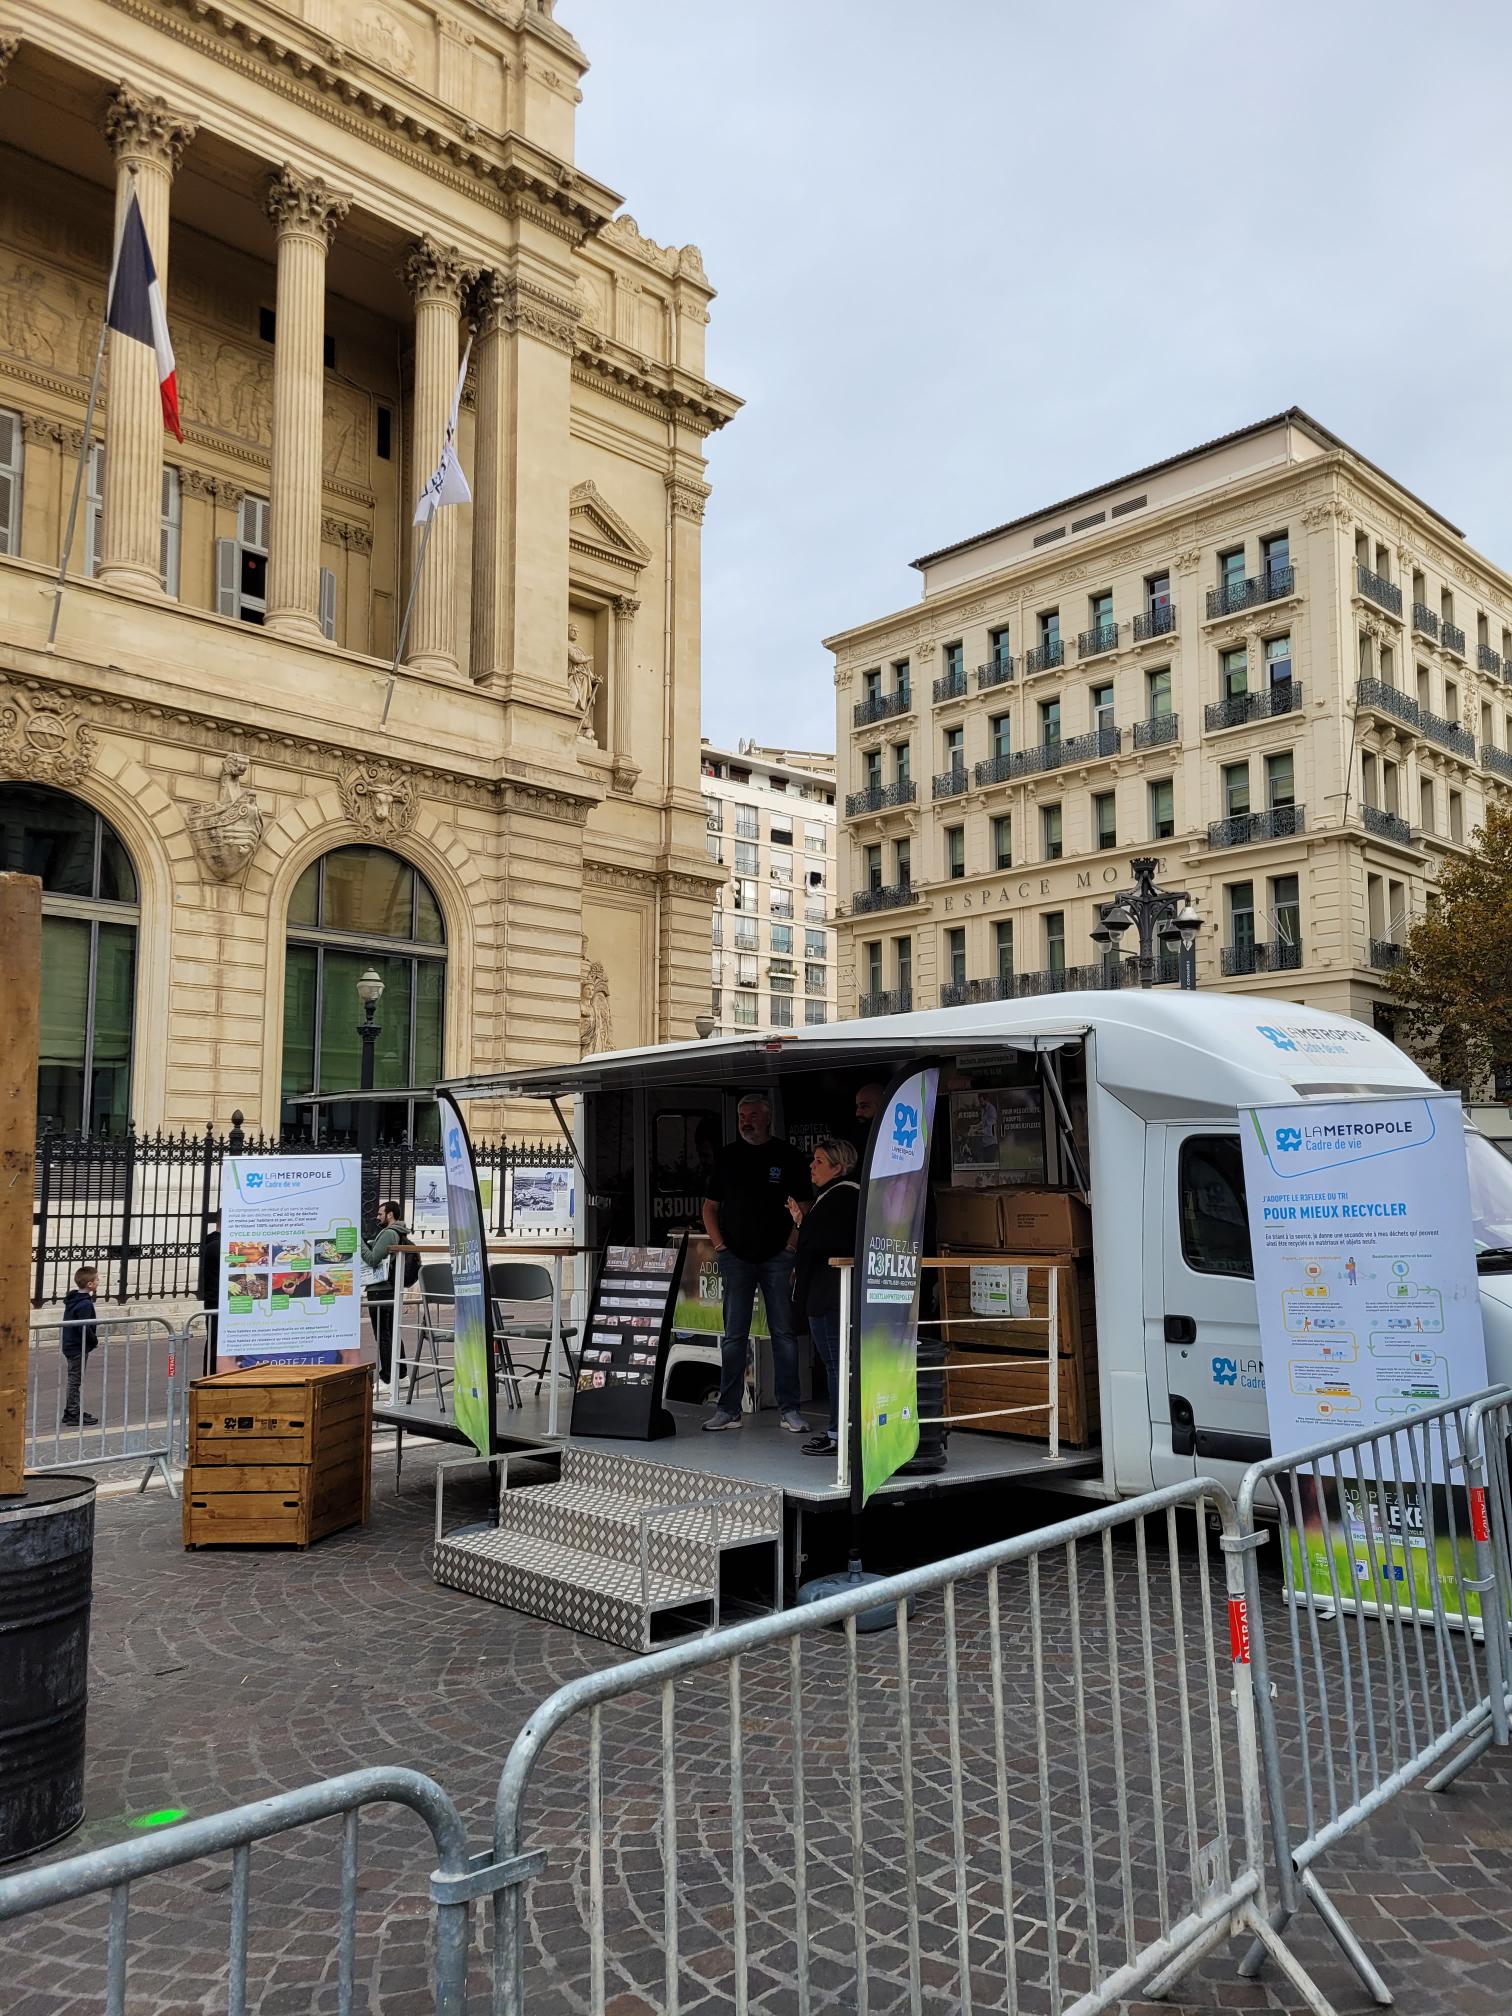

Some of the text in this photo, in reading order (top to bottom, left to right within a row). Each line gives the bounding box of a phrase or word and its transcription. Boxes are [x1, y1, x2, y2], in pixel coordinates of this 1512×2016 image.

[944, 858, 1168, 911] ESPACE MOE
[1305, 1138, 1362, 1151] Cadre de vie
[1262, 1194, 1290, 1203] J'ADOPTE
[1292, 1194, 1299, 1202] LE
[1328, 1192, 1337, 1201] DU
[1338, 1191, 1348, 1200] TRI
[1264, 1203, 1407, 1220] POUR MIEUX RECYCLER
[700, 1261, 721, 1276] ADO
[1241, 1375, 1266, 1389] Cadre
[1239, 1601, 1251, 1661] ALTRAD
